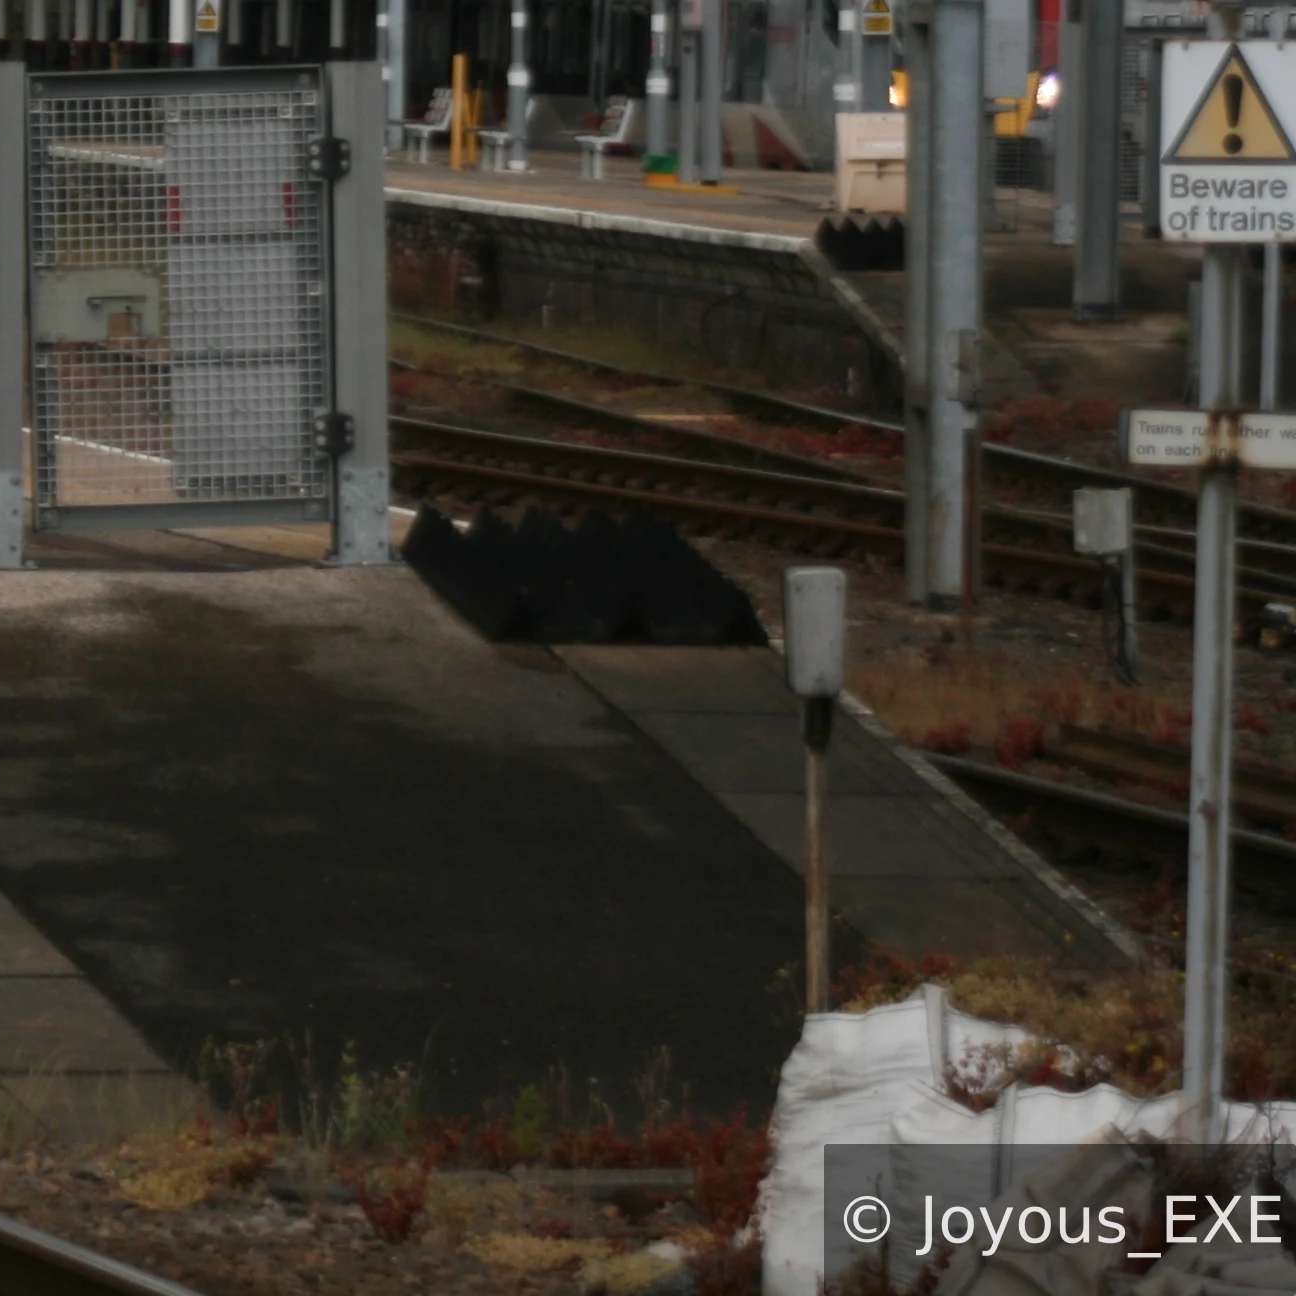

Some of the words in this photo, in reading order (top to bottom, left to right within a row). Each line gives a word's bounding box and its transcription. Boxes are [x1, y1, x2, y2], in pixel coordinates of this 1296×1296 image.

[1170, 173, 1288, 199] Beware
[1169, 205, 1199, 232] of
[1206, 205, 1295, 232] trains
[1137, 421, 1183, 435] Trains
[1279, 429, 1296, 439] wa
[1136, 444, 1156, 455] on
[1164, 444, 1201, 457] each
